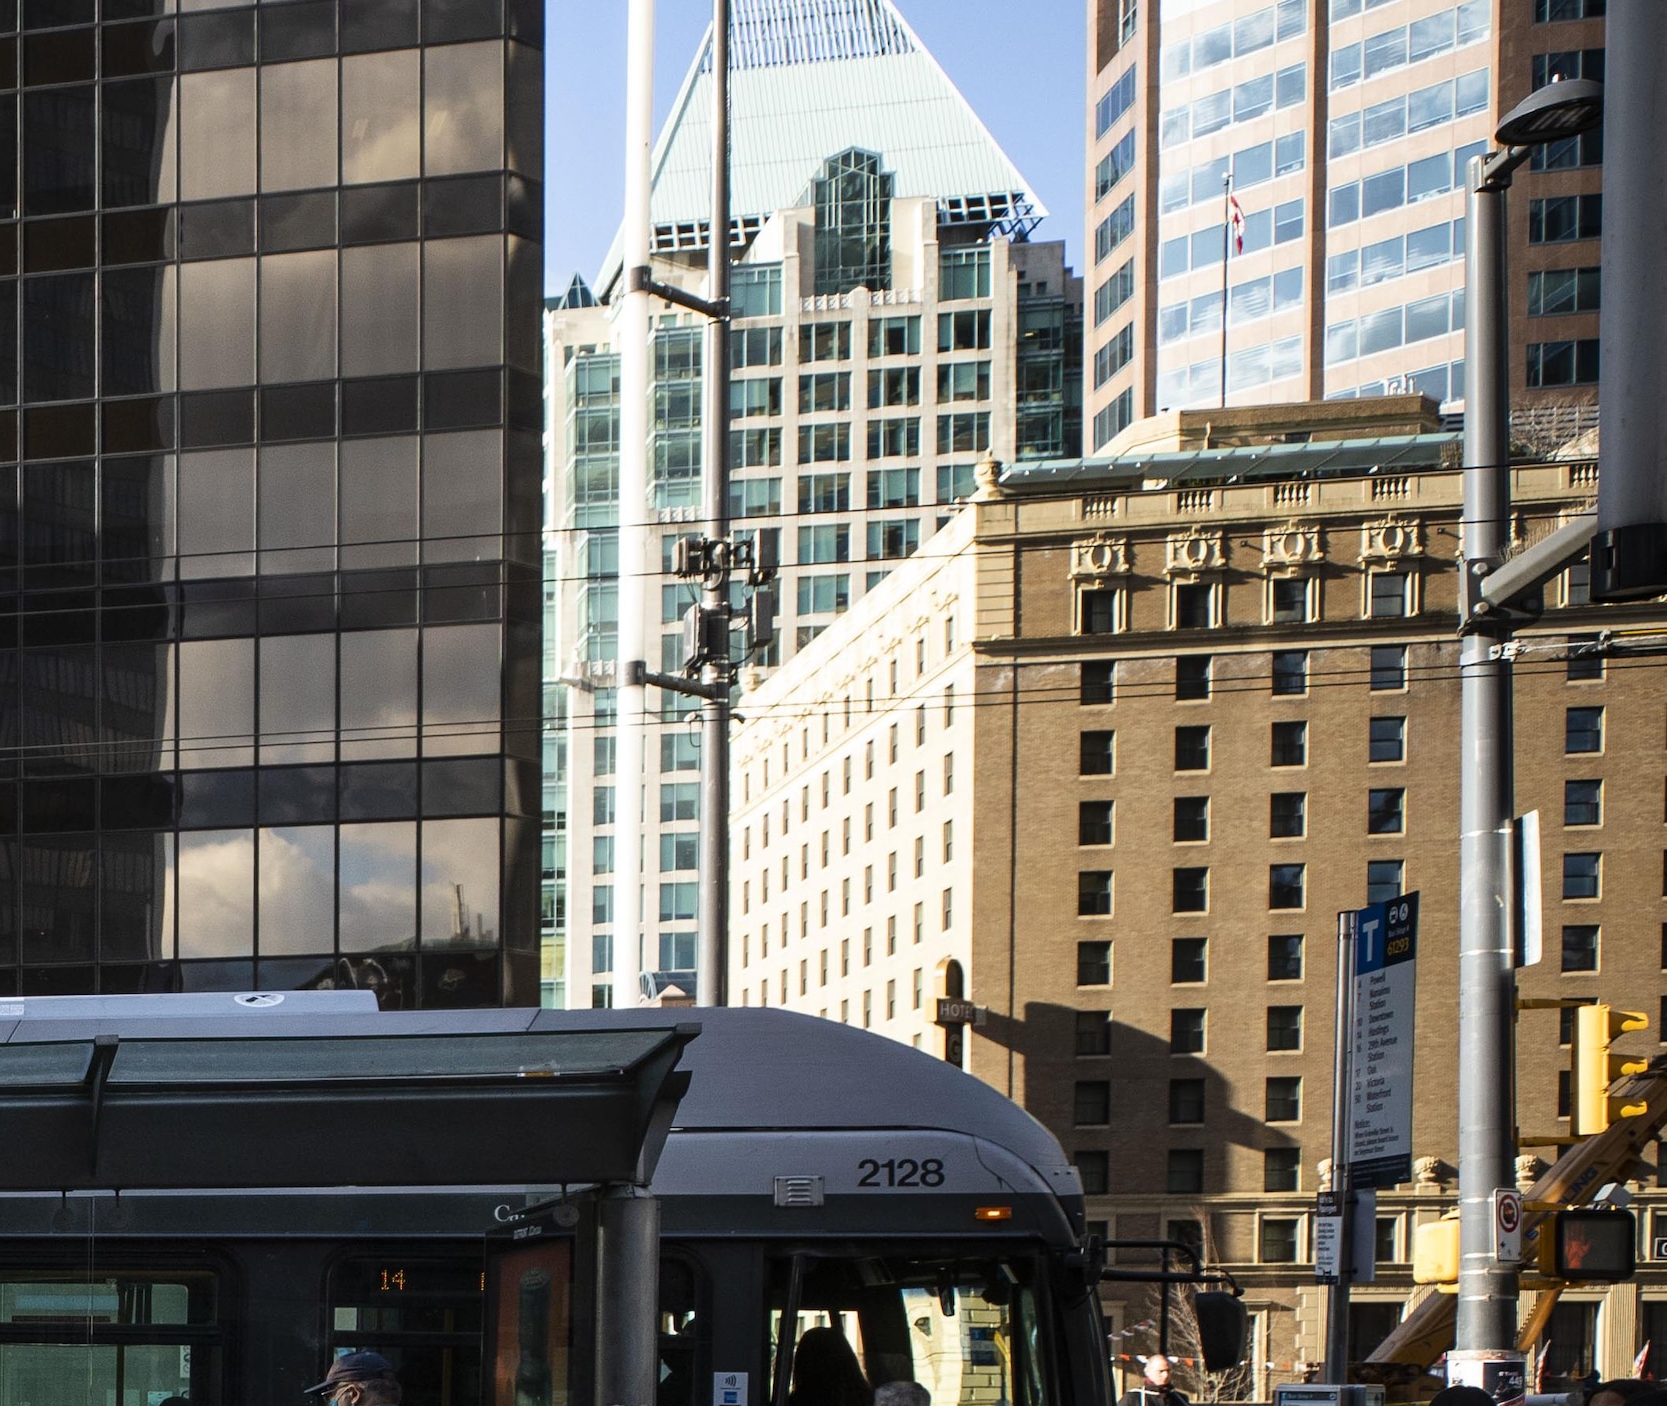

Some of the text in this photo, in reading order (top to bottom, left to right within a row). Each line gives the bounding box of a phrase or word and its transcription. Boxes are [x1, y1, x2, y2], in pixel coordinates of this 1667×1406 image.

[1387, 938, 1410, 956] 61293
[1369, 1010, 1394, 1024] Downtown
[1368, 1024, 1389, 1037] Hastings
[1368, 1038, 1379, 1051] 29th
[1379, 1036, 1398, 1047] Avenue
[1368, 1051, 1385, 1063] Station
[1366, 1102, 1384, 1114] Station
[858, 1159, 945, 1187] 2128
[380, 1268, 406, 1291] 14
